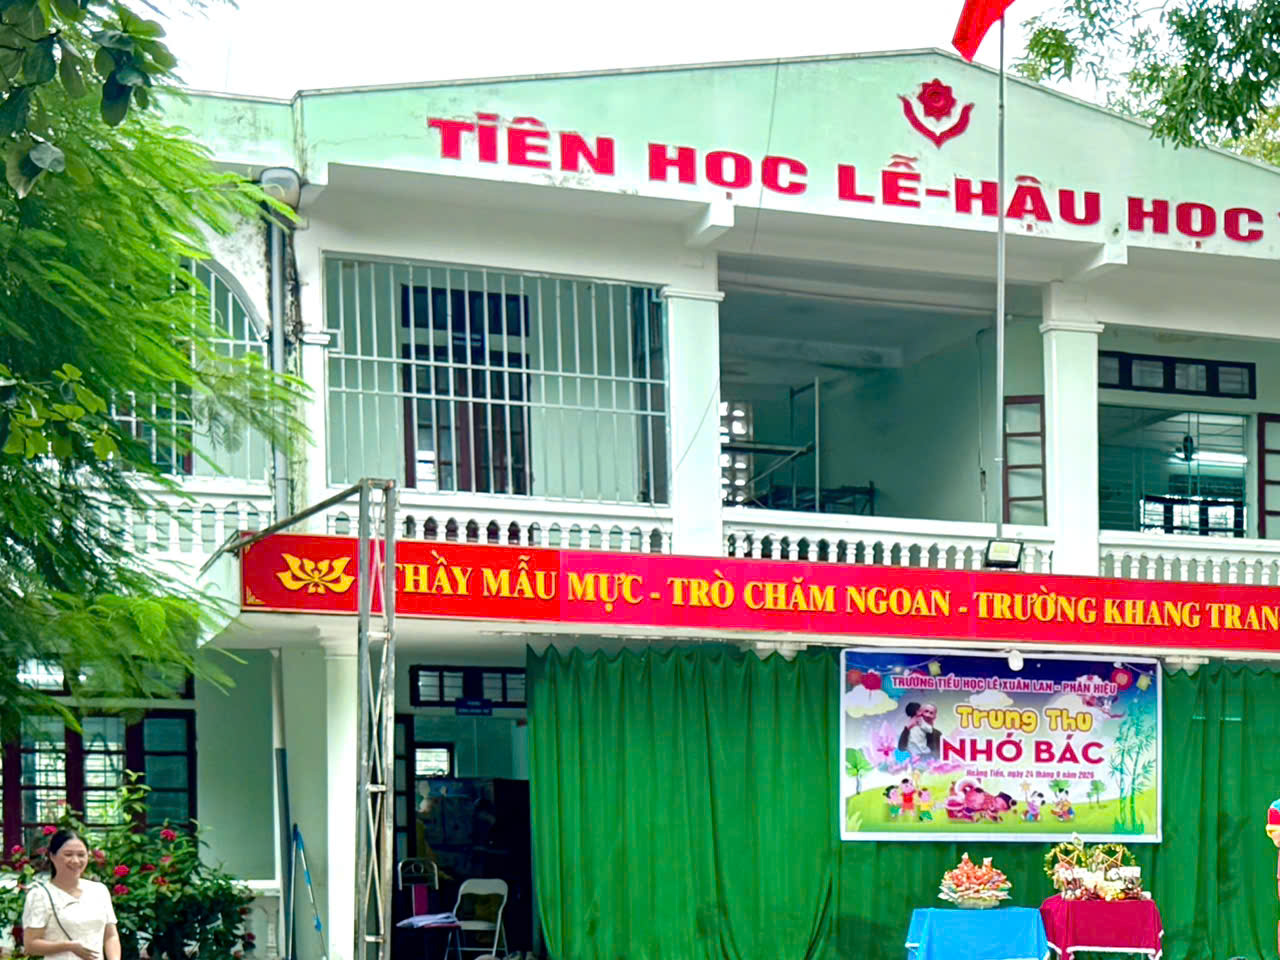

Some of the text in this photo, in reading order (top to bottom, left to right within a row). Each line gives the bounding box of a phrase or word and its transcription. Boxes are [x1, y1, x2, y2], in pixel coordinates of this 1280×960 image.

[648, 142, 808, 200] HỌC
[1128, 196, 1264, 249] HỌC
[481, 554, 557, 600] MẪU
[567, 572, 643, 613] MỰC
[667, 569, 735, 609] TRÒ
[743, 576, 836, 613] CHĂM
[845, 585, 951, 617] NGOAN
[973, 585, 1097, 624] TRƯỜNG
[1104, 599, 1201, 629] KHANG
[891, 674, 936, 689] TRƯỜNG
[937, 673, 961, 690] TIỂU
[963, 678, 985, 692] HỌC
[987, 676, 999, 690] LÊ
[1001, 679, 1031, 691] XUÂN
[1032, 680, 1053, 692] LAN
[956, 704, 1093, 734] Trung Thu
[942, 732, 1105, 765] NHỚ BÁC
